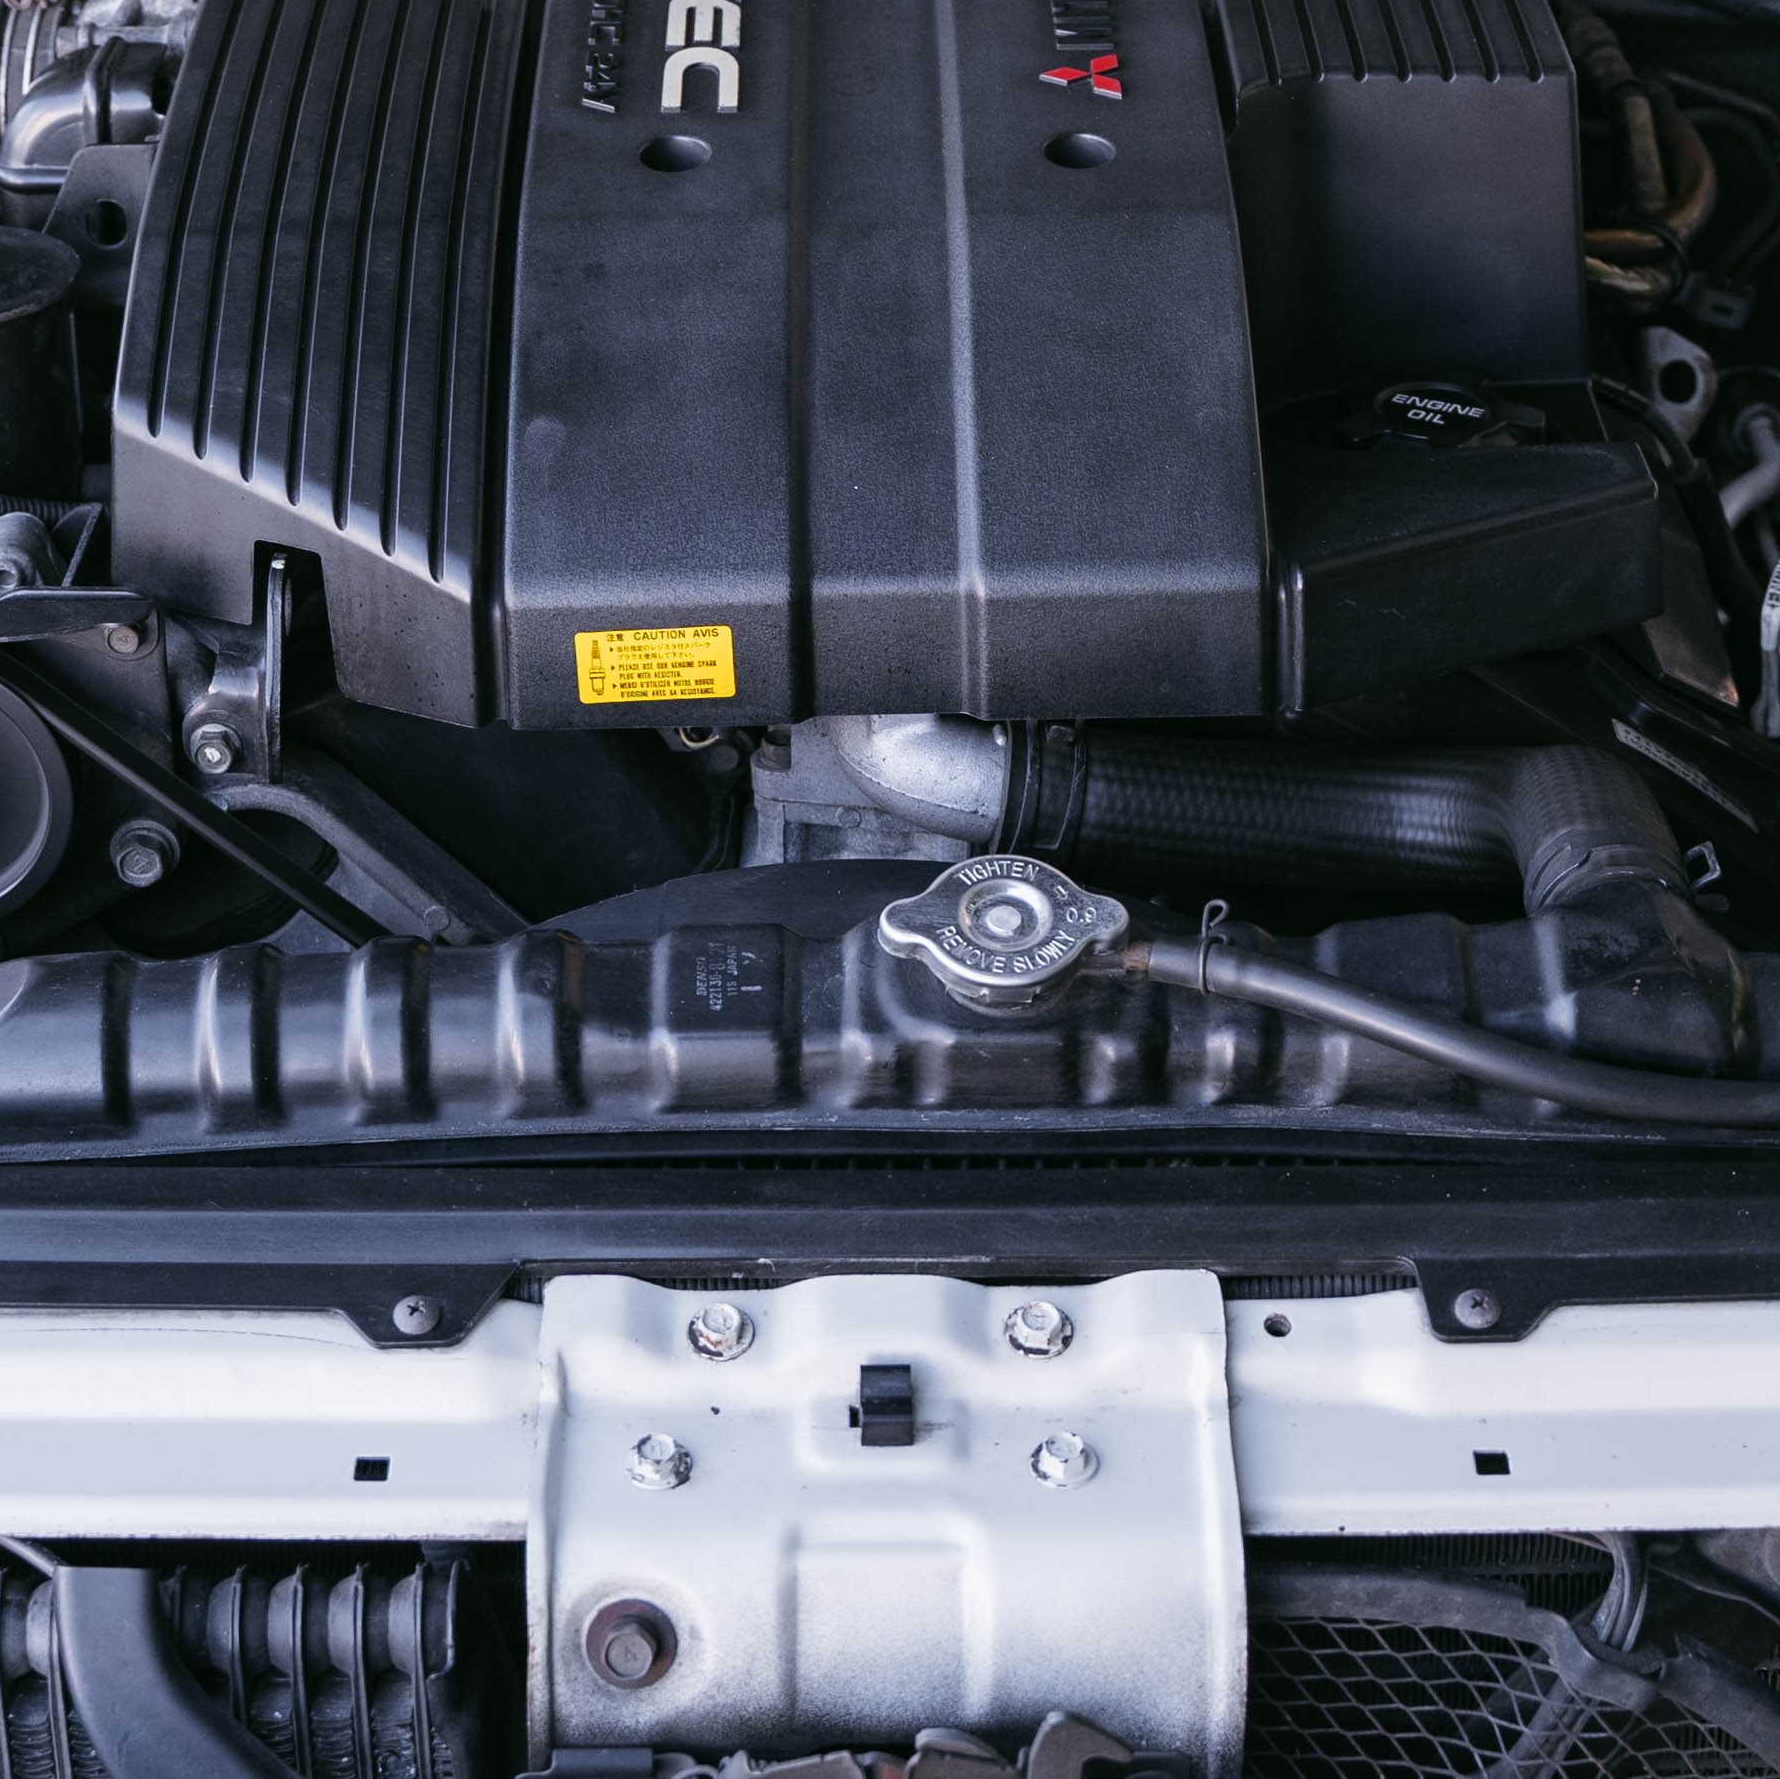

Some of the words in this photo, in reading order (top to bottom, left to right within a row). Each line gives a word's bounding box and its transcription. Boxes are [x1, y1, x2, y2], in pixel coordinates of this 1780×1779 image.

[1391, 393, 1486, 418] ENGINE
[1406, 408, 1446, 426] OIL
[633, 629, 686, 641] CAUTION
[692, 628, 719, 638] AVIS
[953, 859, 1040, 887] TIGHTEN
[1065, 906, 1098, 925] 0.9
[725, 945, 739, 976] JAPAN
[934, 924, 1006, 974] REMOVE
[1011, 928, 1078, 975] SLOWLY
[695, 955, 708, 997] DENSO
